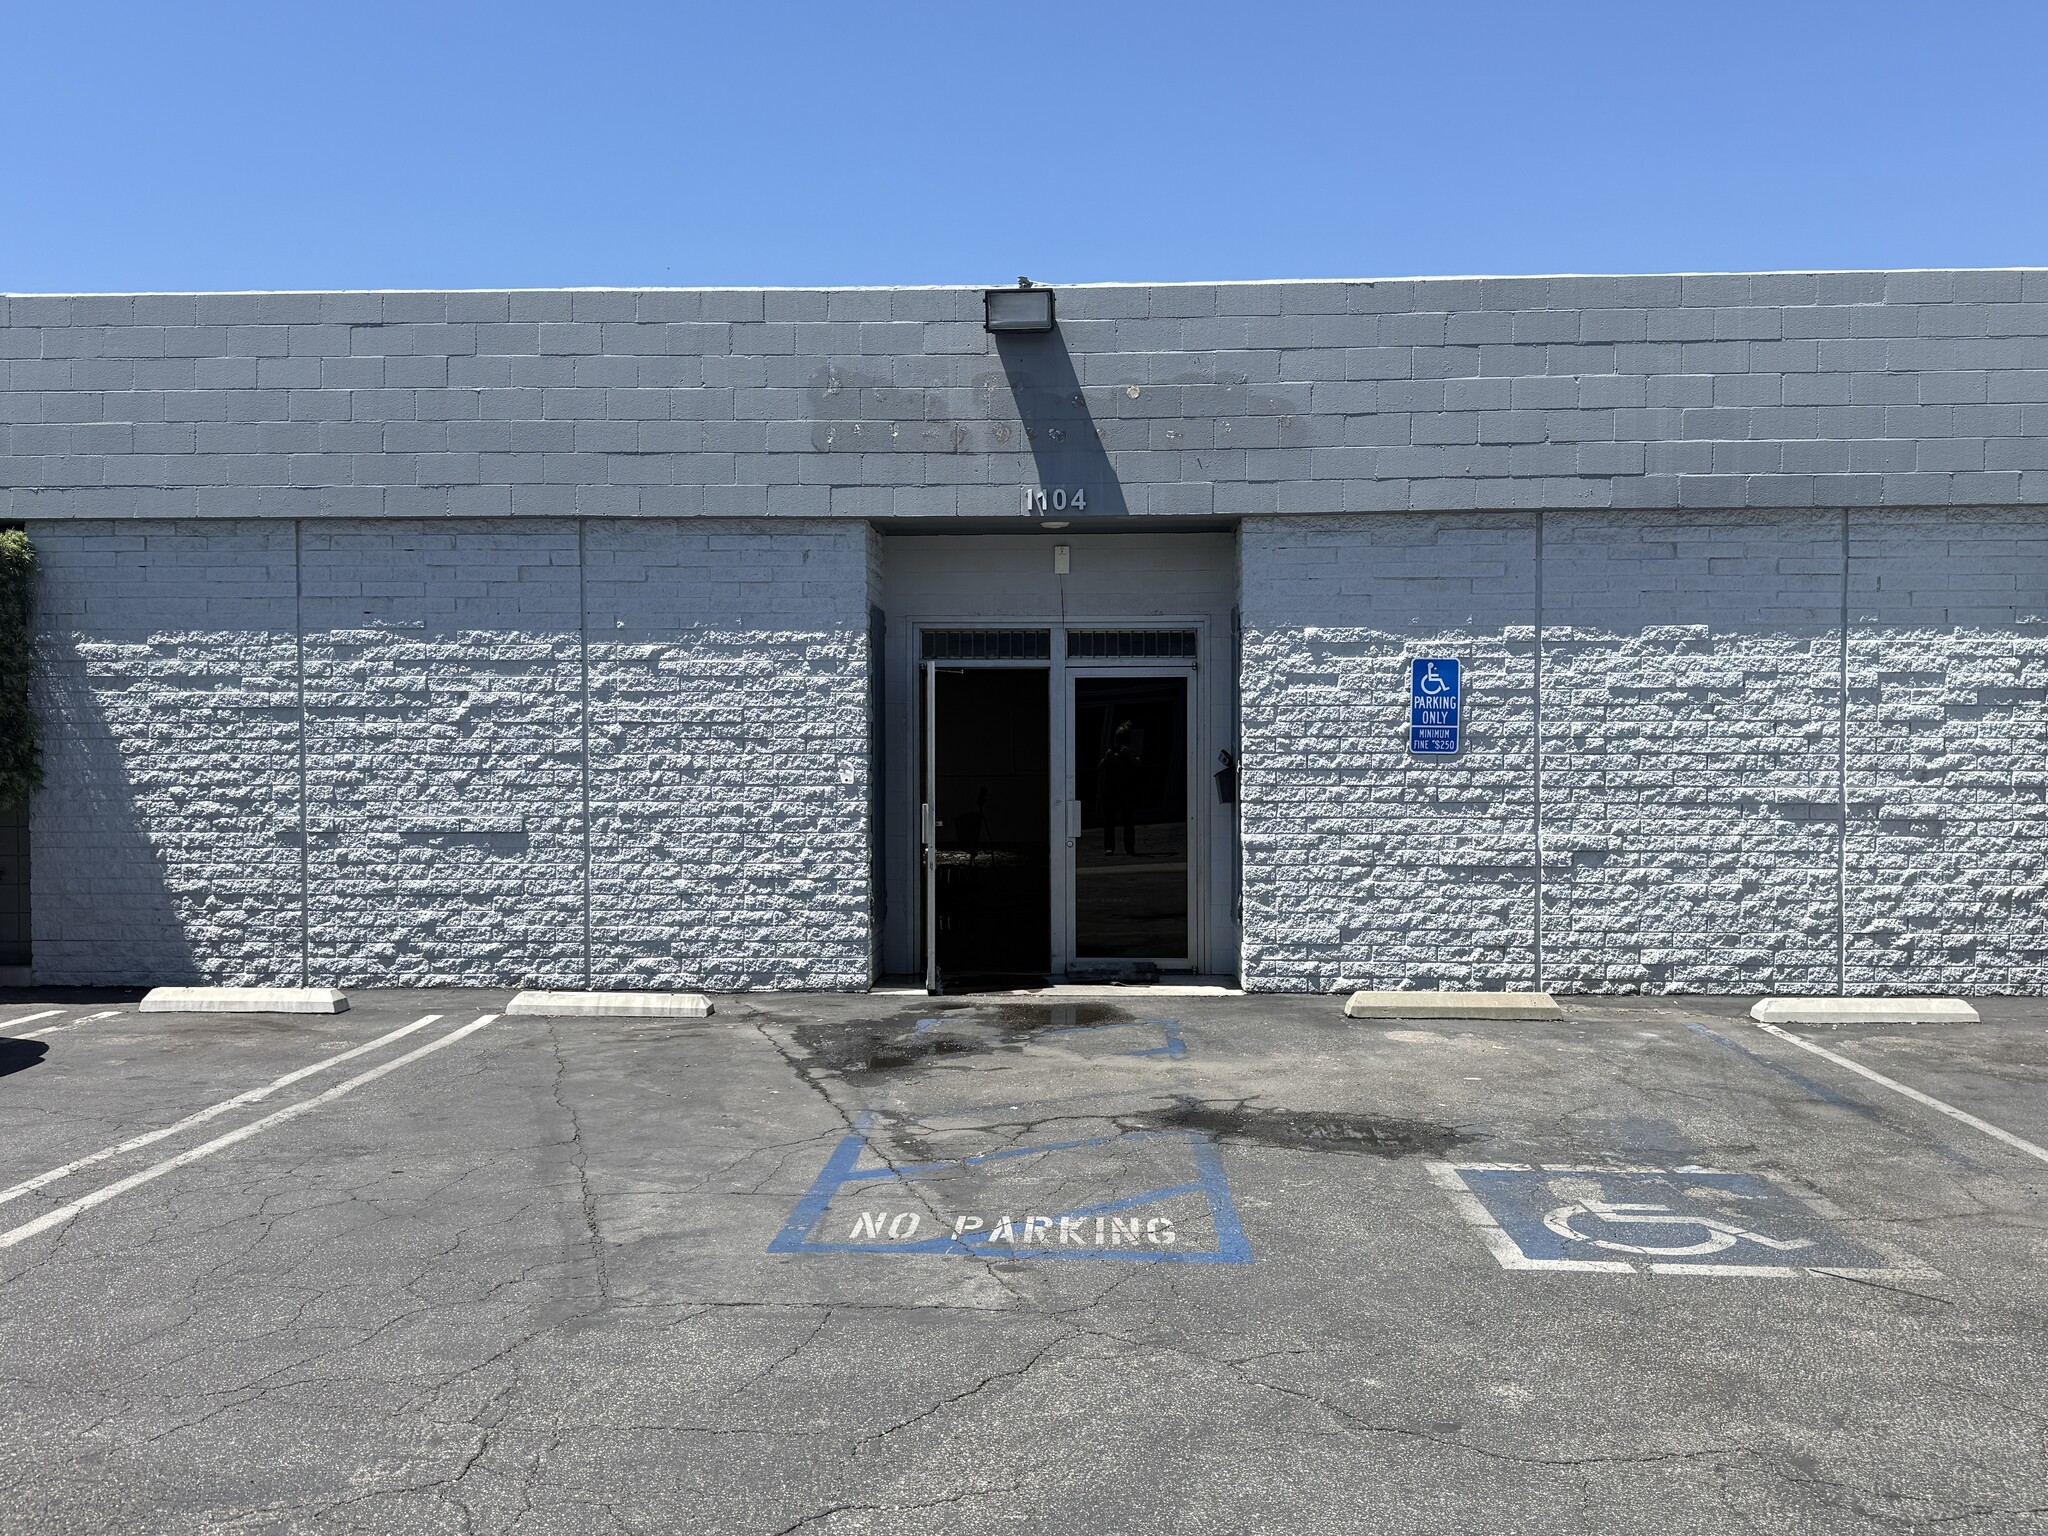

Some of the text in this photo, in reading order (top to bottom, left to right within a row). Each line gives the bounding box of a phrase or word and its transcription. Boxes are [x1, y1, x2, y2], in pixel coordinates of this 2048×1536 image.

[1025, 488, 1087, 511] 1104
[1414, 696, 1457, 709] PARKING
[1422, 711, 1448, 724] ONLY
[1419, 729, 1450, 738] MINIMUM
[1413, 740, 1455, 750] FINE $250
[849, 1211, 1177, 1245] NO PARKING
